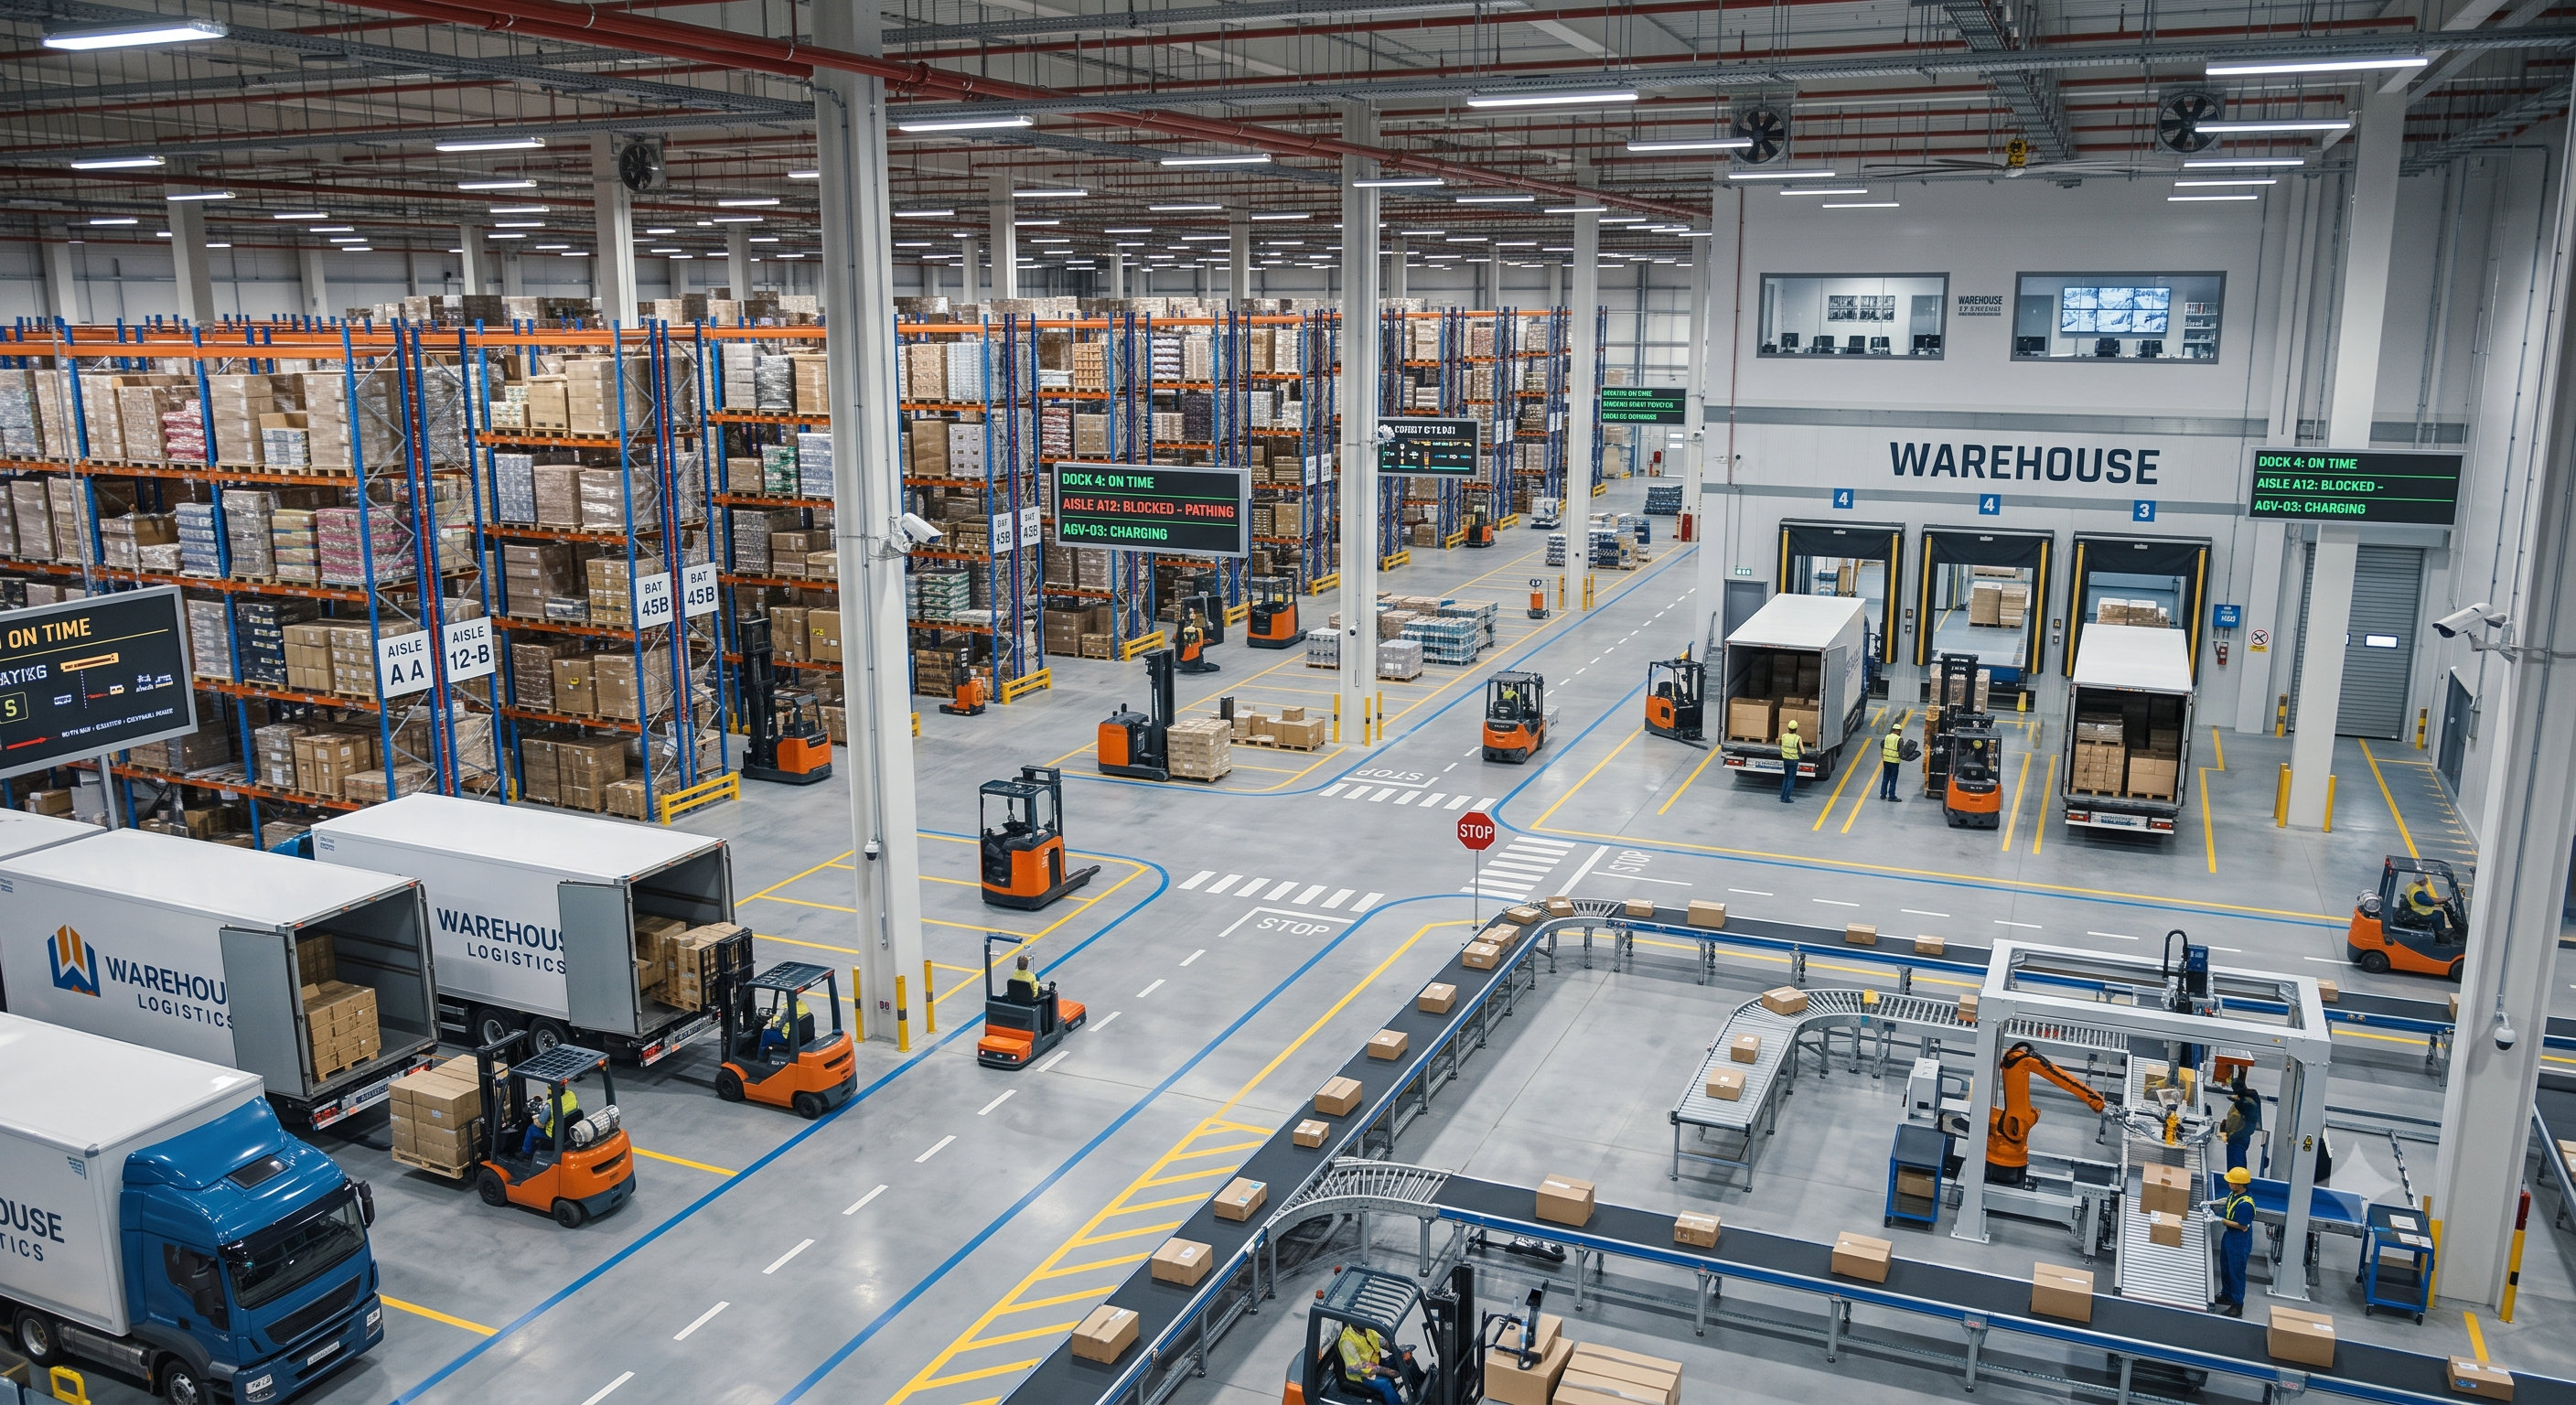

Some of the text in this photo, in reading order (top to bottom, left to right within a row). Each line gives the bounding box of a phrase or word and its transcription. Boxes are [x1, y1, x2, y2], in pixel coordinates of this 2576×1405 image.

[1959, 295, 2002, 305] WAREHOUSE
[1890, 442, 2160, 485] WAREHOUSE
[2259, 456, 2358, 469] DOCK 4: ON TIME
[1062, 473, 1154, 488] DOCK 4: ON TIME
[2257, 477, 2291, 488] AISLE
[2292, 479, 2318, 490] A12:
[2321, 480, 2375, 492] BLOCKED
[1839, 491, 1849, 506] 4
[1983, 498, 1994, 512] 4
[2255, 500, 2366, 514] AGV-03: CHARGING
[1063, 498, 1094, 510] AISLE
[1097, 499, 1121, 512] A12:
[1123, 501, 1175, 515] BLOCKED
[1186, 504, 1235, 519] PATHING
[2139, 503, 2150, 518] 3
[1063, 523, 1167, 540] AGV-03: CHARGING
[691, 571, 708, 584] BAT
[645, 581, 662, 595] BAT
[688, 585, 715, 606] 45B
[642, 596, 669, 617] 45B
[7, 617, 91, 649] ON TIME
[452, 626, 485, 644] AISLE
[388, 638, 423, 659] AISLE
[450, 644, 490, 670] 12-B
[1356, 768, 1424, 781] STOP
[1460, 823, 1493, 840] STOP
[1608, 850, 1652, 873] STOP
[1256, 917, 1330, 937] STOP
[467, 942, 566, 975] LOGISTICS
[104, 956, 227, 1005] WAREHOU
